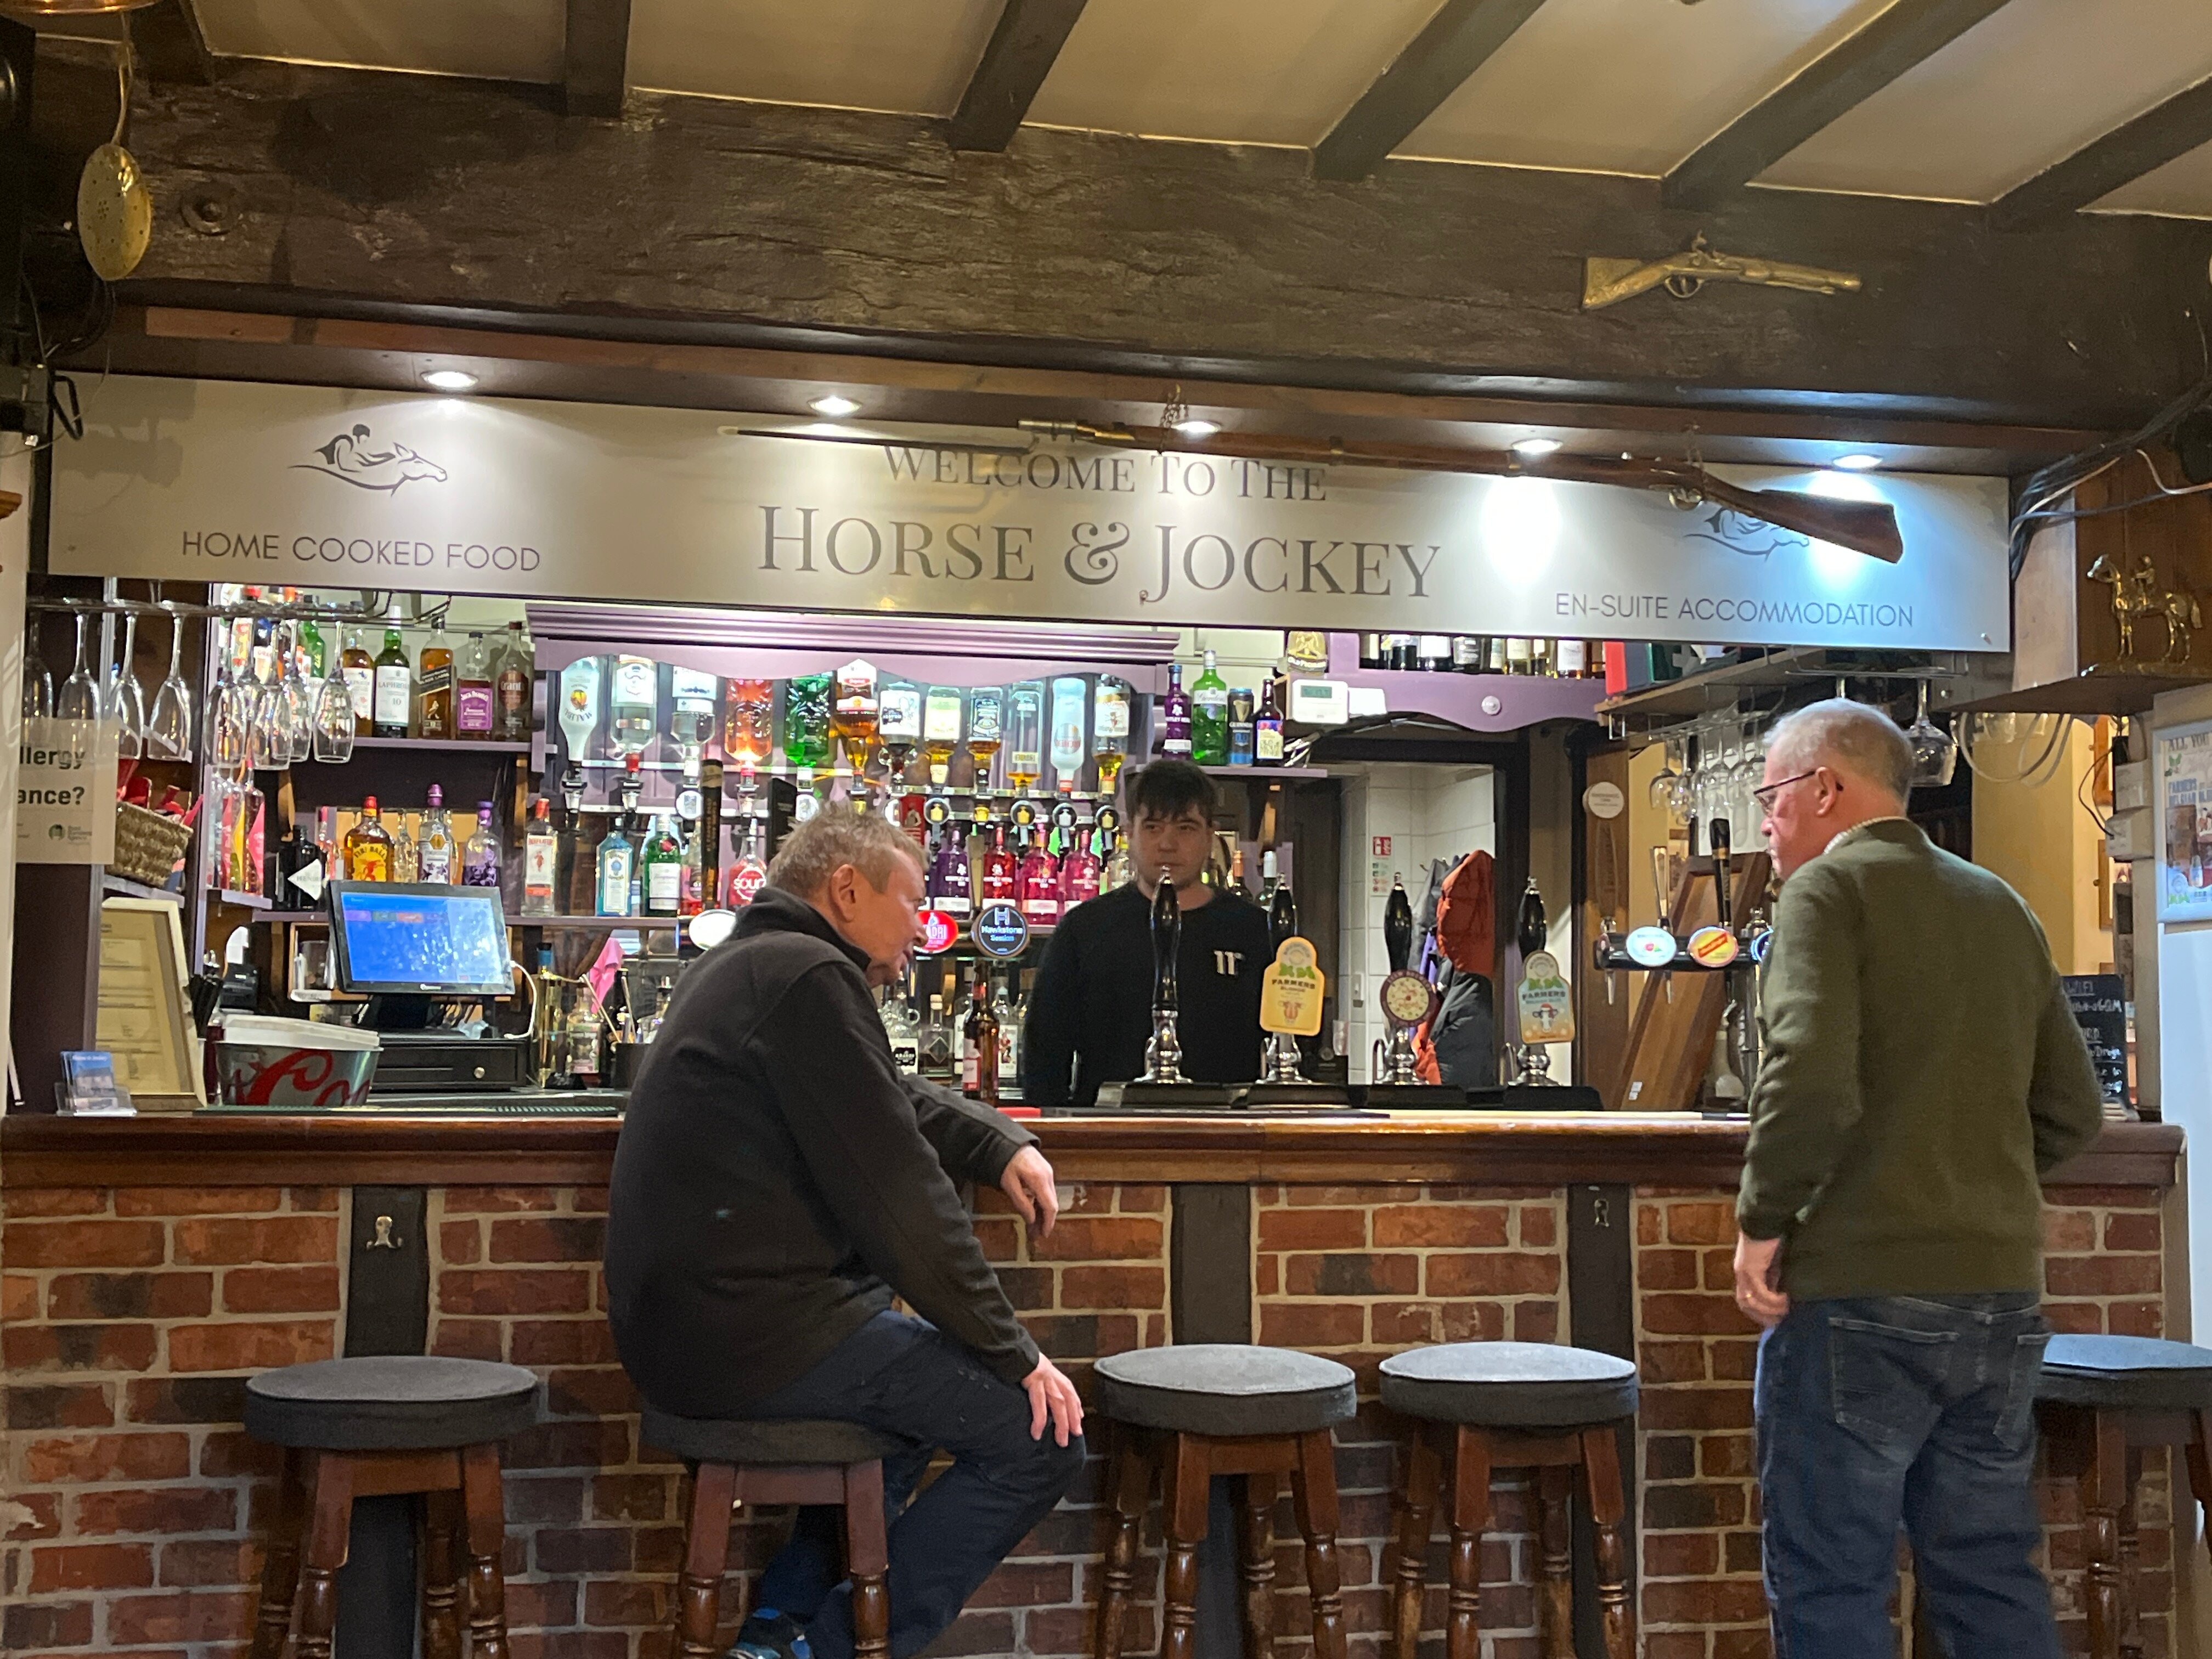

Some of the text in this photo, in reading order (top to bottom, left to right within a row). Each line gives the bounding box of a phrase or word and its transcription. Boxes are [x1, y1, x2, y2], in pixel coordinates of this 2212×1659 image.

[884, 446, 1327, 501] WELCOME TO THE
[183, 531, 540, 571] HOME COOKED FOOD
[758, 506, 1441, 605] HORSE & JOCKEY
[1556, 592, 1913, 627] EN-SUITE ACCOMMODATION
